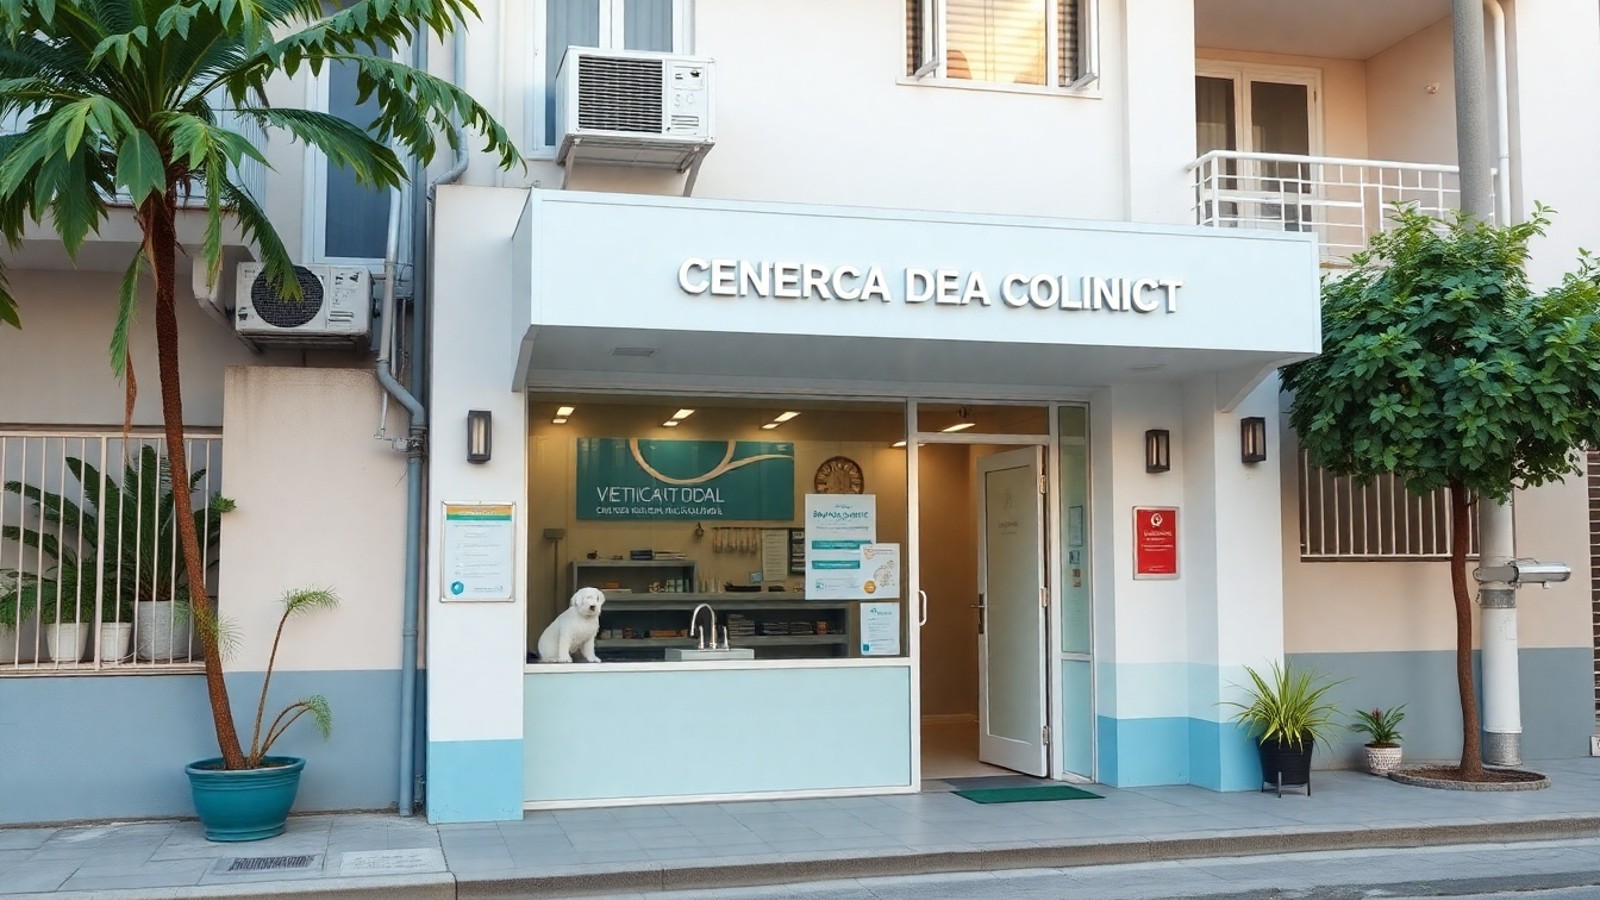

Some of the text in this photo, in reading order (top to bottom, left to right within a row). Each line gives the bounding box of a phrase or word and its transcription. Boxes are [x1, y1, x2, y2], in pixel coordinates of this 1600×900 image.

[677, 257, 1184, 314] CENERCA DEA COLINICT
